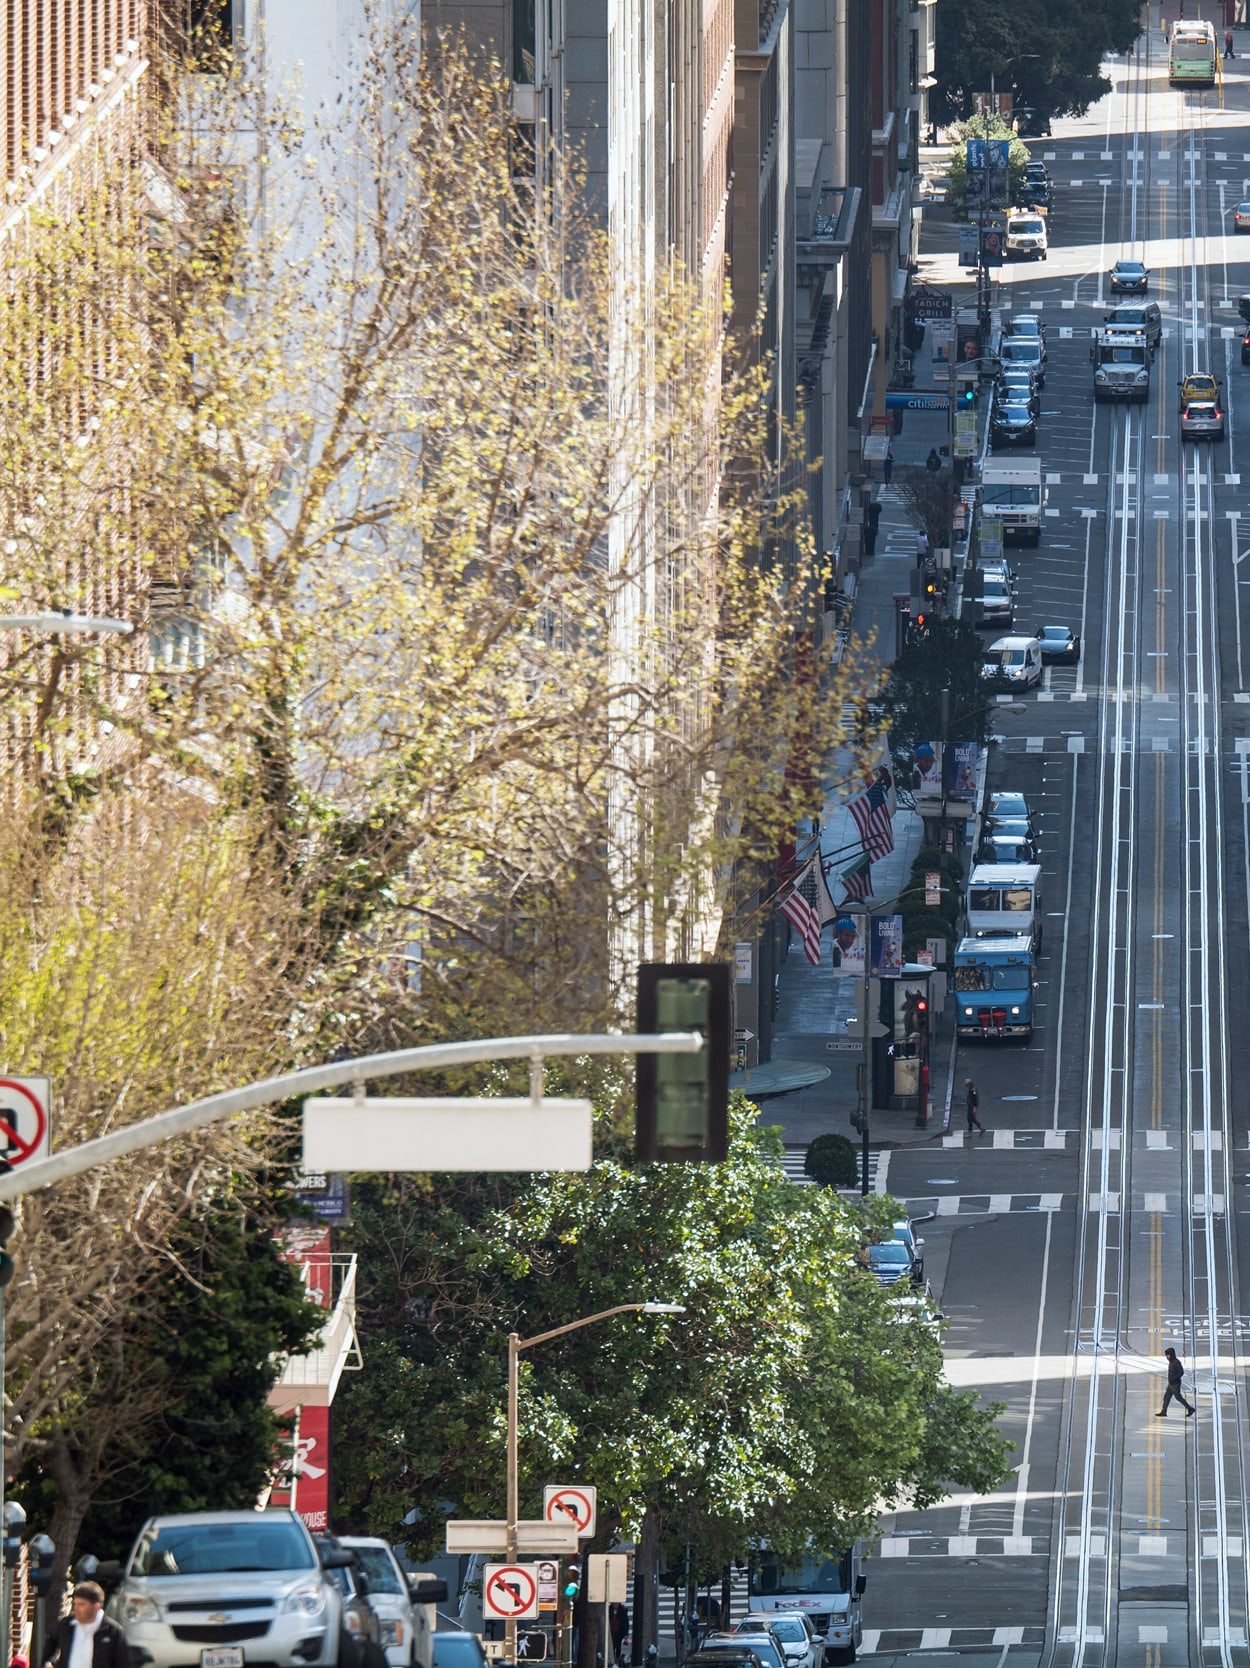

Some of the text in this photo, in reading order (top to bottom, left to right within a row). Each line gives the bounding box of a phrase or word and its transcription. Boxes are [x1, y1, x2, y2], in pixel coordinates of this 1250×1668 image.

[914, 300, 949, 308] TADICH
[918, 309, 944, 317] GRILL
[955, 748, 969, 756] BOLD
[879, 921, 895, 930] BOLD
[774, 1600, 822, 1609] FedEx
